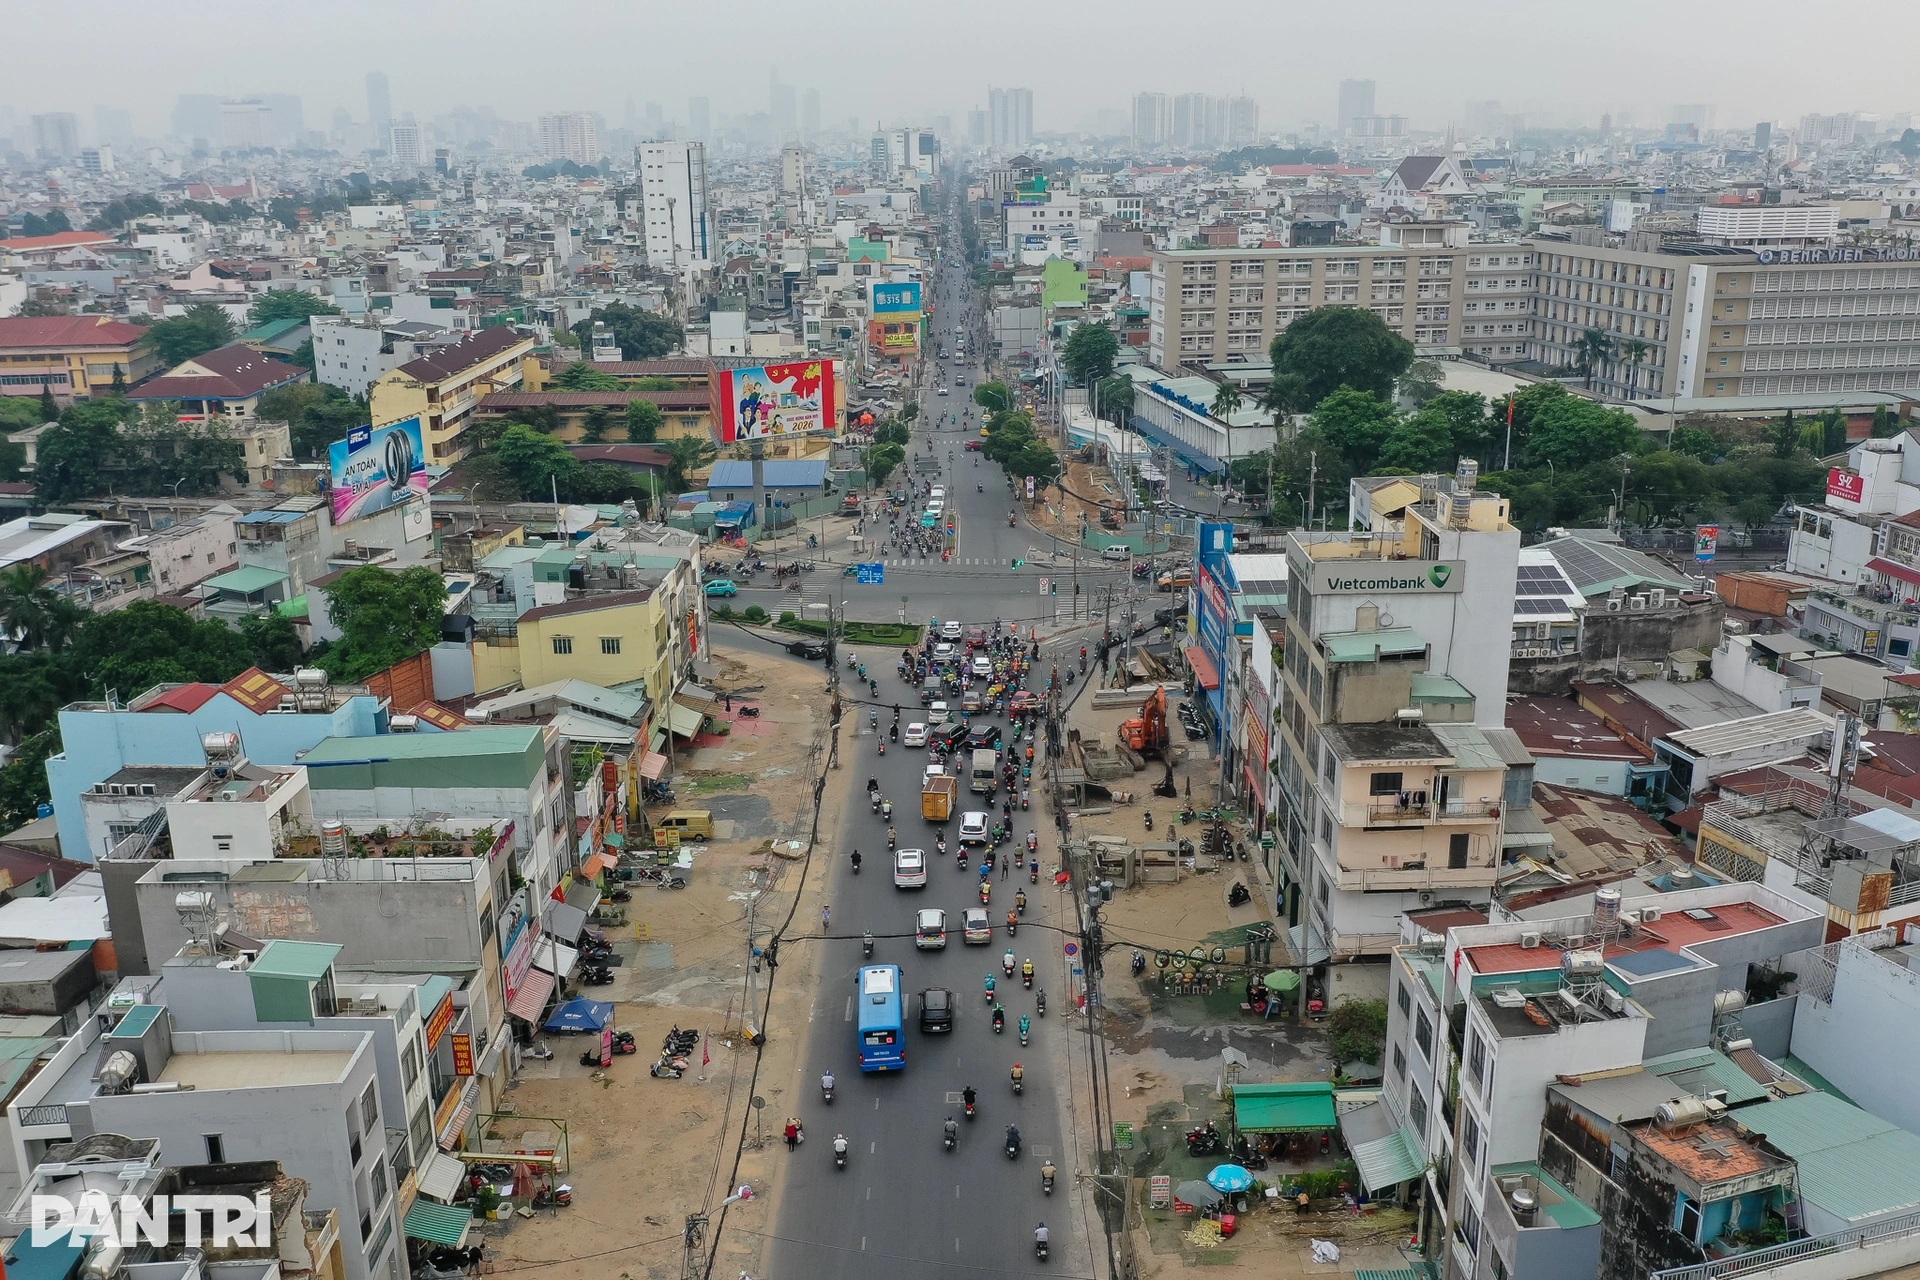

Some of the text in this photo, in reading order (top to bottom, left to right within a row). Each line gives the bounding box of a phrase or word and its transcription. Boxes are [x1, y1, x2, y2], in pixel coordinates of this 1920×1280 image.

[886, 296, 900, 304] 315
[792, 420, 814, 431] 2026
[344, 457, 377, 477] AN TOÀN
[1837, 474, 1854, 489] SHZ
[1327, 576, 1426, 590] Vietcombank
